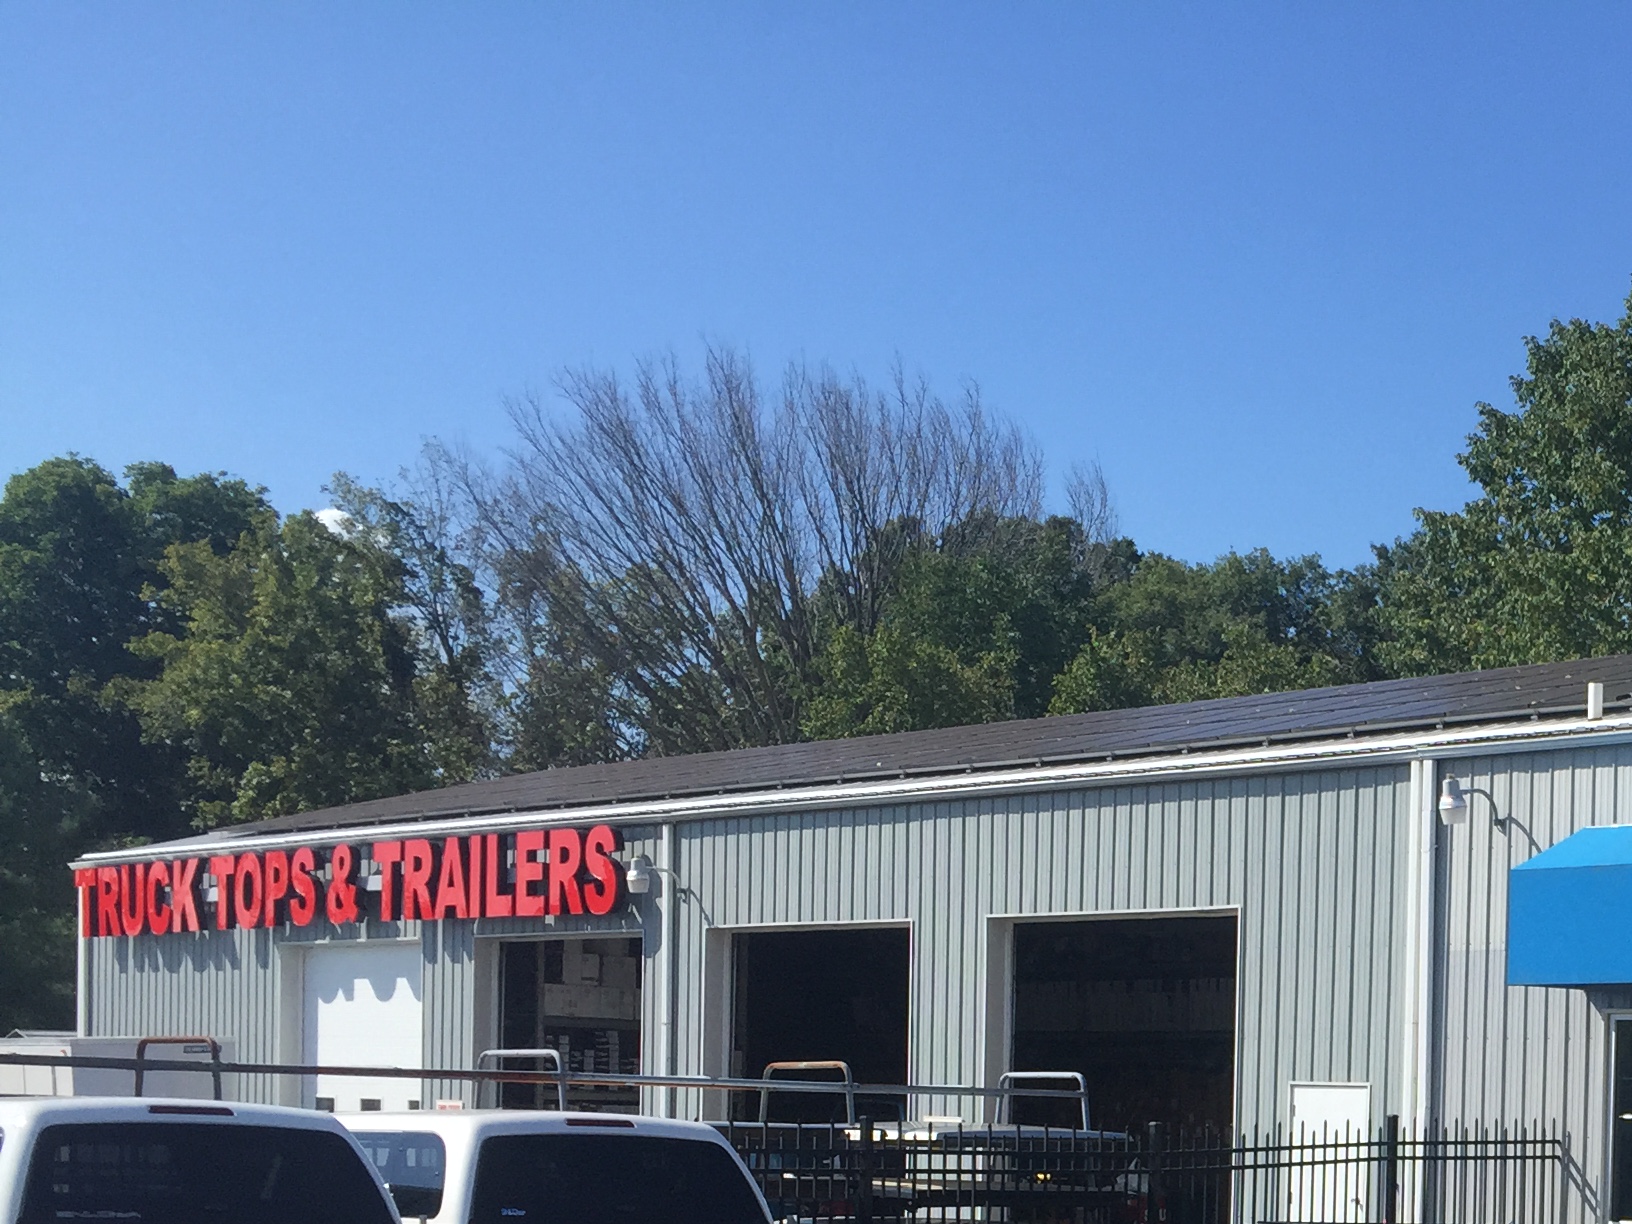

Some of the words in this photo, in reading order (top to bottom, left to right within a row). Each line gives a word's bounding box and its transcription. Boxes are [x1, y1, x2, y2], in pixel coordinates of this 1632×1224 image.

[75, 857, 199, 938] TRUCK
[209, 847, 317, 931] TOPS
[326, 843, 358, 925] &
[372, 825, 617, 922] TRAILERS
